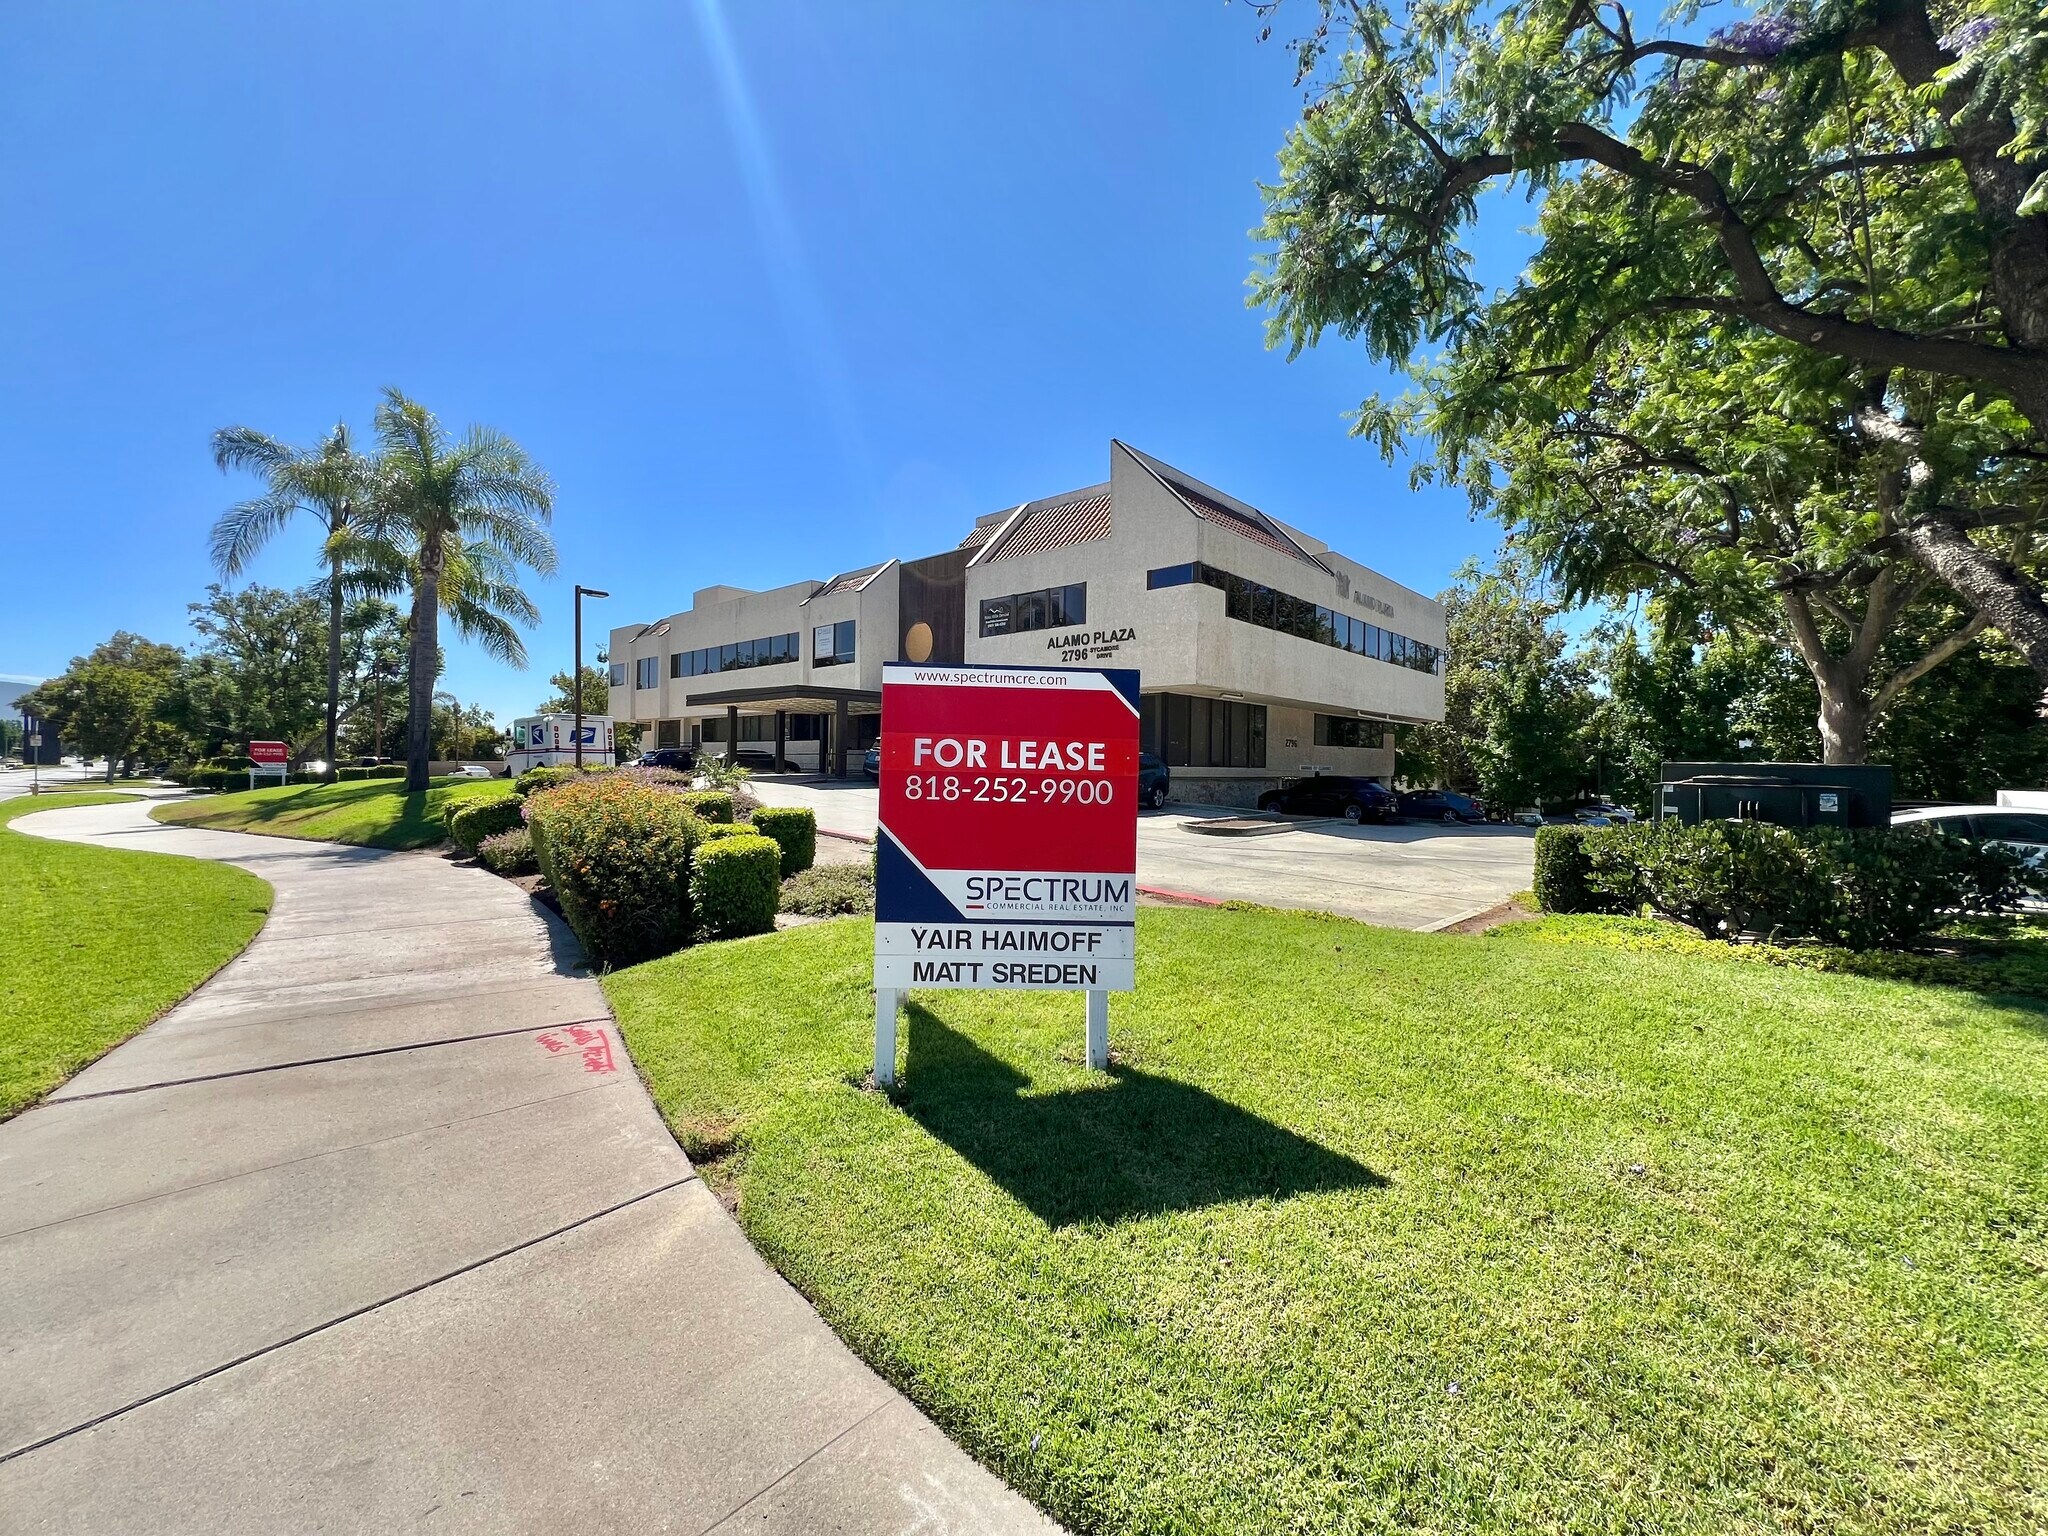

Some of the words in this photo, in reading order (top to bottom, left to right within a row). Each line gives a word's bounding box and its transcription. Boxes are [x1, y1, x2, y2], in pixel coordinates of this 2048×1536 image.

[1047, 633, 1090, 650] ALAMO
[1094, 628, 1136, 645] PLAZA
[1061, 648, 1088, 663] 2796
[1089, 645, 1120, 653] SYCAMORE
[914, 671, 1068, 686] www.spectrumcre.com
[913, 738, 987, 769] FOR
[1000, 740, 1106, 771] LEASE
[904, 775, 1114, 805] 818-252-9900
[966, 876, 1129, 903] SPECTRUM
[986, 902, 1045, 911] COMMERCIAL
[1073, 904, 1107, 912] ESTATE,
[911, 928, 972, 949] YAIR
[981, 930, 1102, 952] HAIMOFF
[913, 961, 984, 982] MATT
[991, 963, 1097, 984] SREDEN
